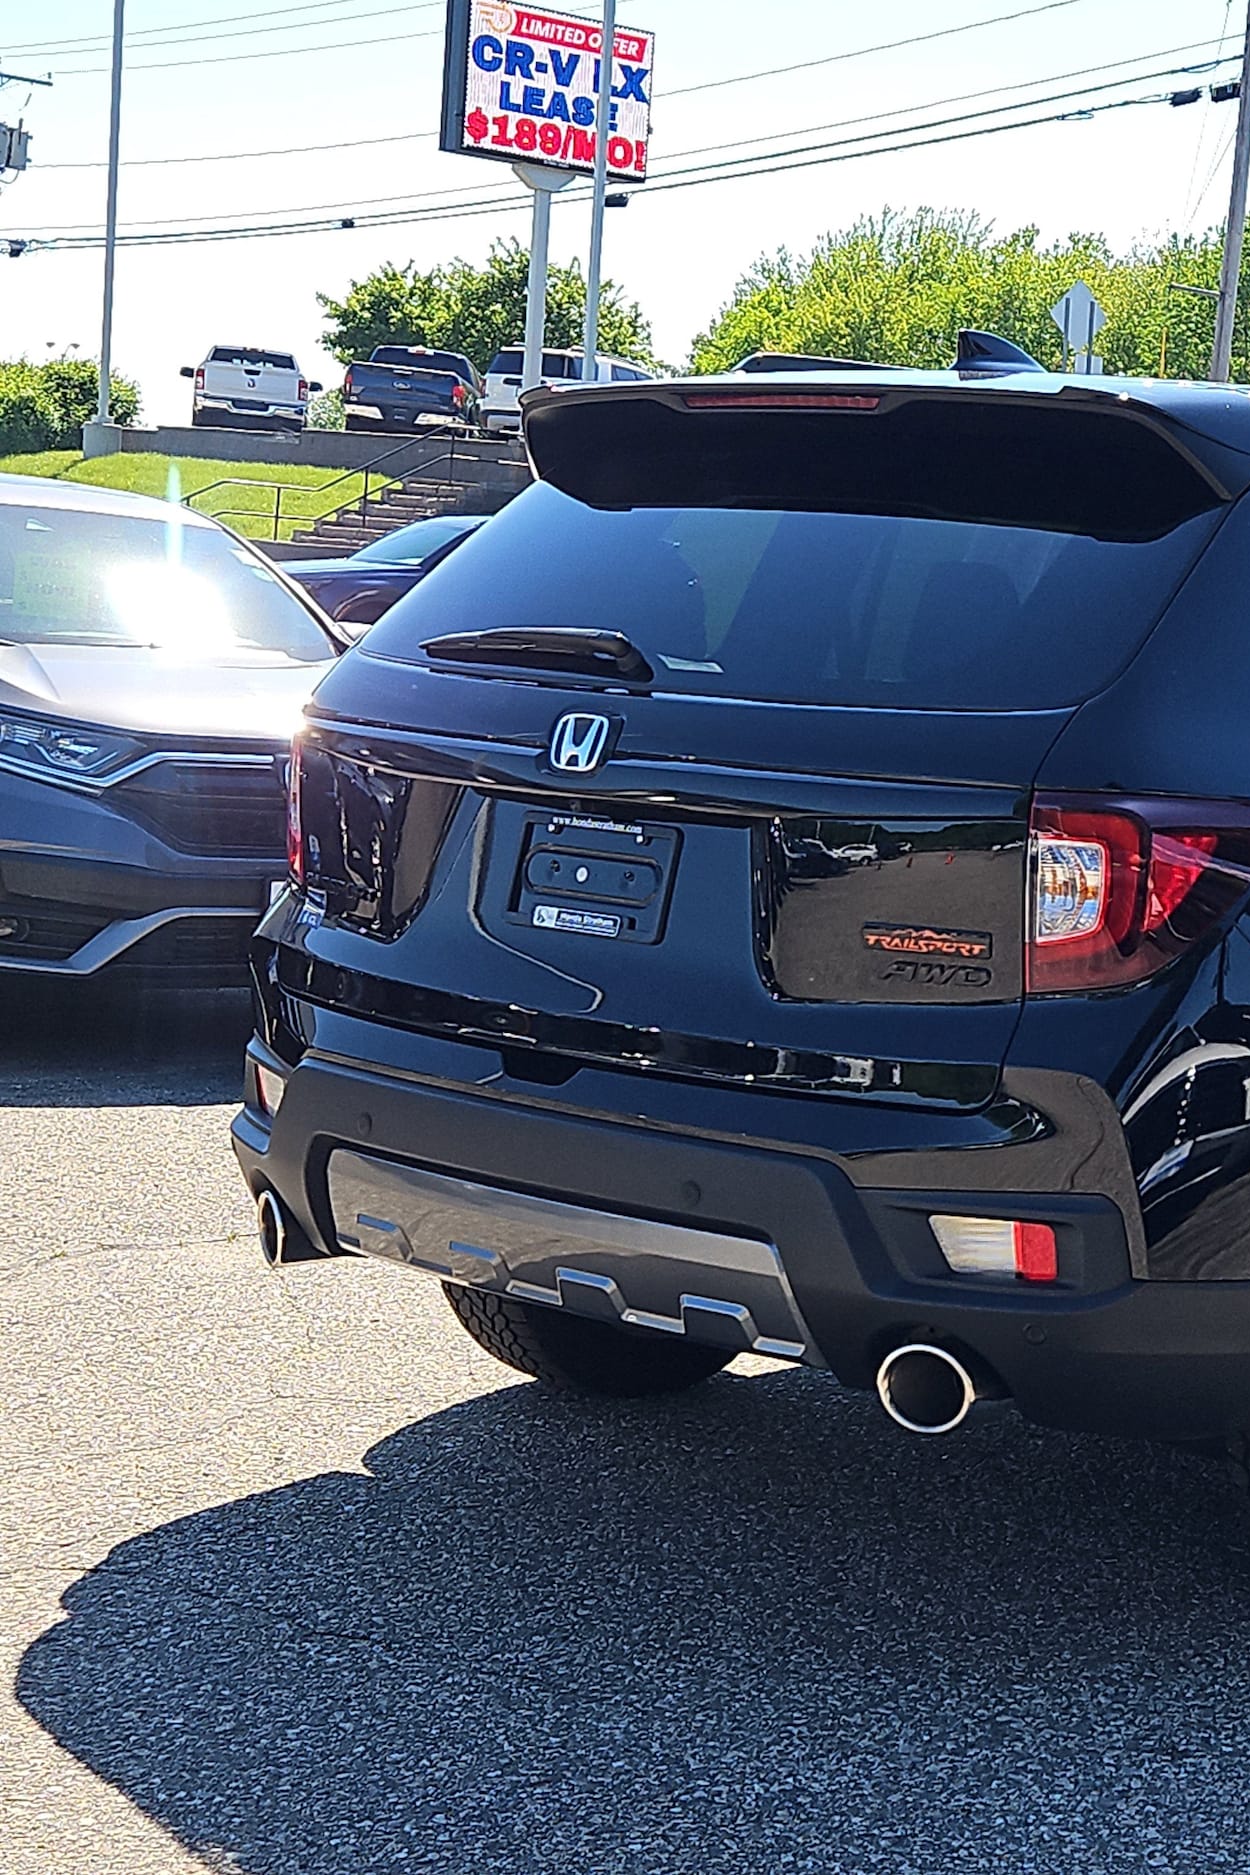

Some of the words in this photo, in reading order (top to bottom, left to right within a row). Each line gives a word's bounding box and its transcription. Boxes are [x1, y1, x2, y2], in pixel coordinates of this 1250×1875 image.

[521, 17, 586, 45] LIMITED
[588, 32, 640, 57] OFER
[472, 34, 581, 87] CR-V
[499, 80, 618, 131] LEASE
[864, 934, 986, 957] TRAILSPORT
[878, 960, 993, 987] AWD
